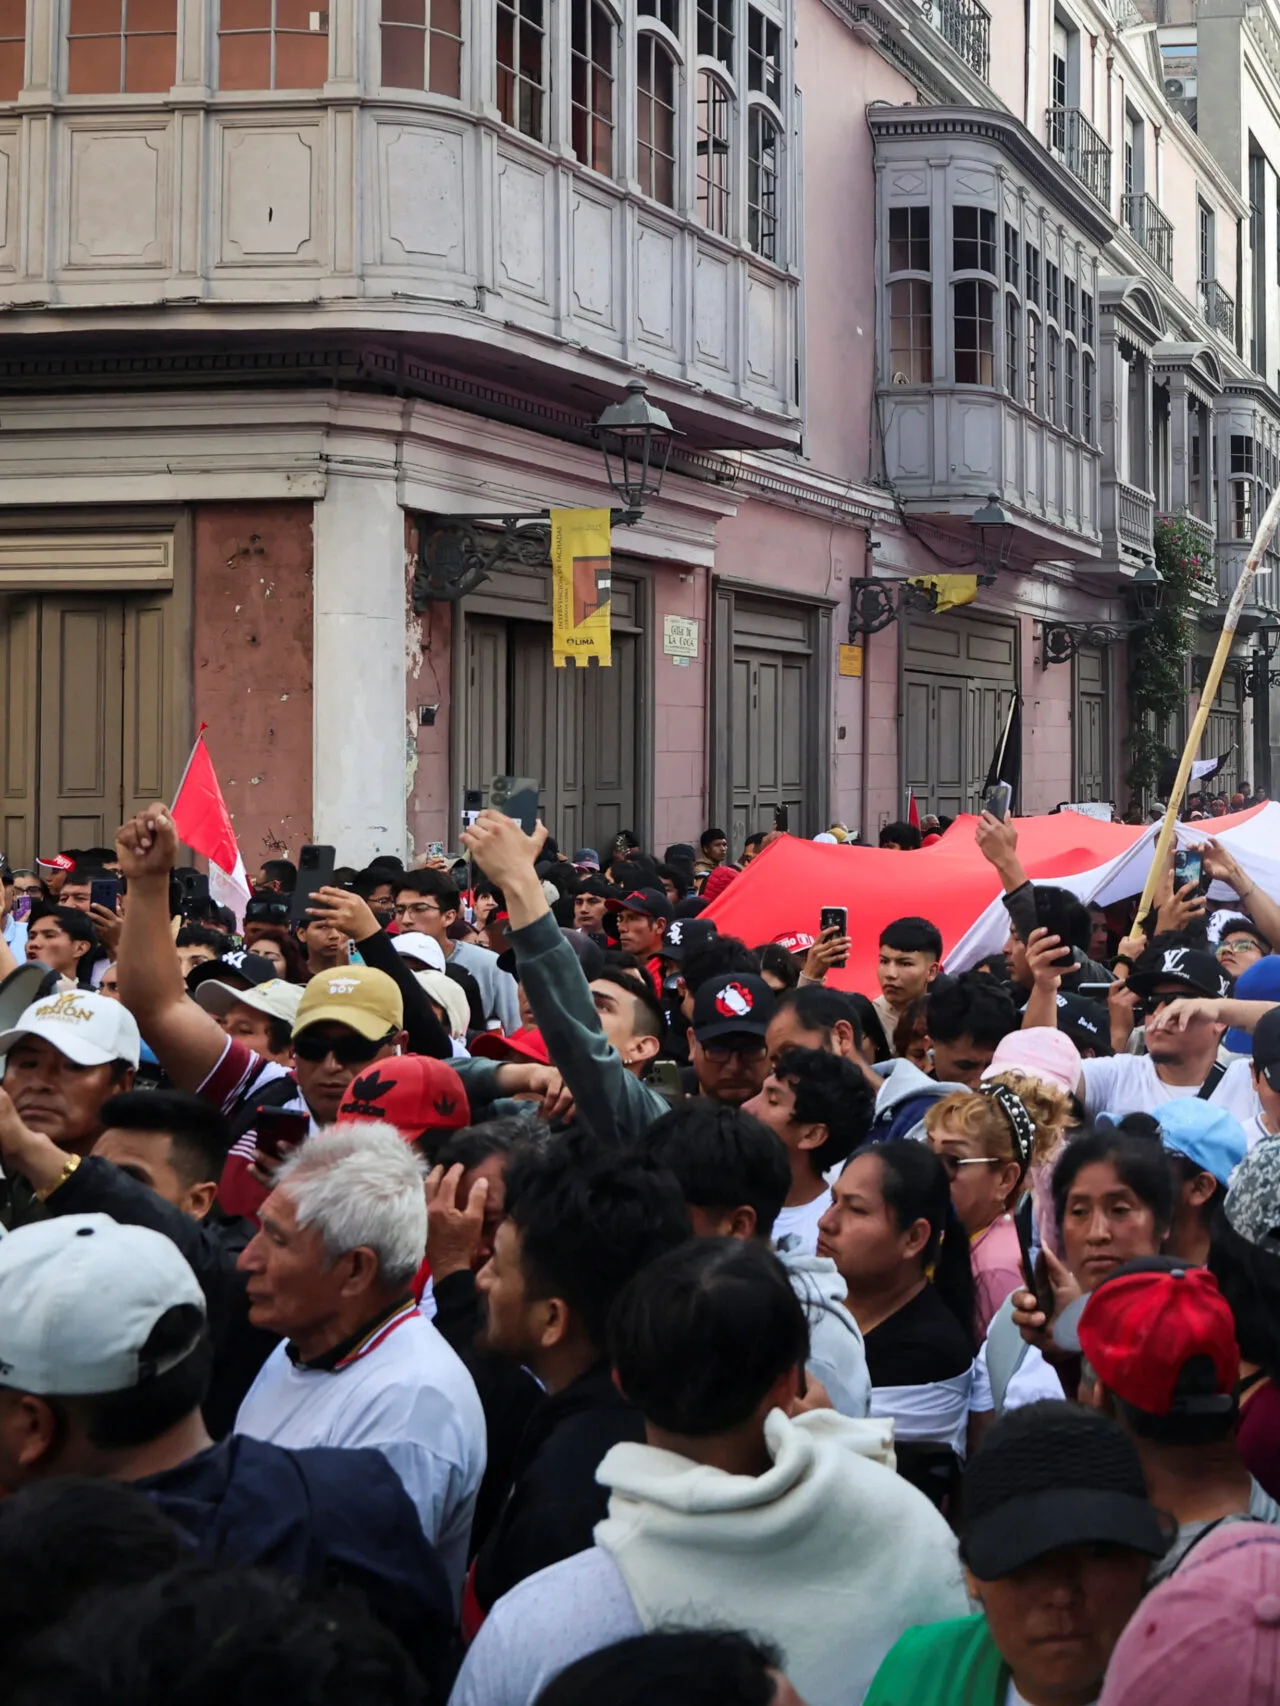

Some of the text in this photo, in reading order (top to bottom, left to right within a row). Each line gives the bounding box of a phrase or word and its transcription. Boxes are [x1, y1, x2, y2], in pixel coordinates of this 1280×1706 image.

[575, 638, 594, 646] LIMA
[668, 635, 677, 645] LA
[1161, 947, 1189, 972] LV
[328, 986, 355, 995] BOY
[341, 1100, 386, 1117] adidas
